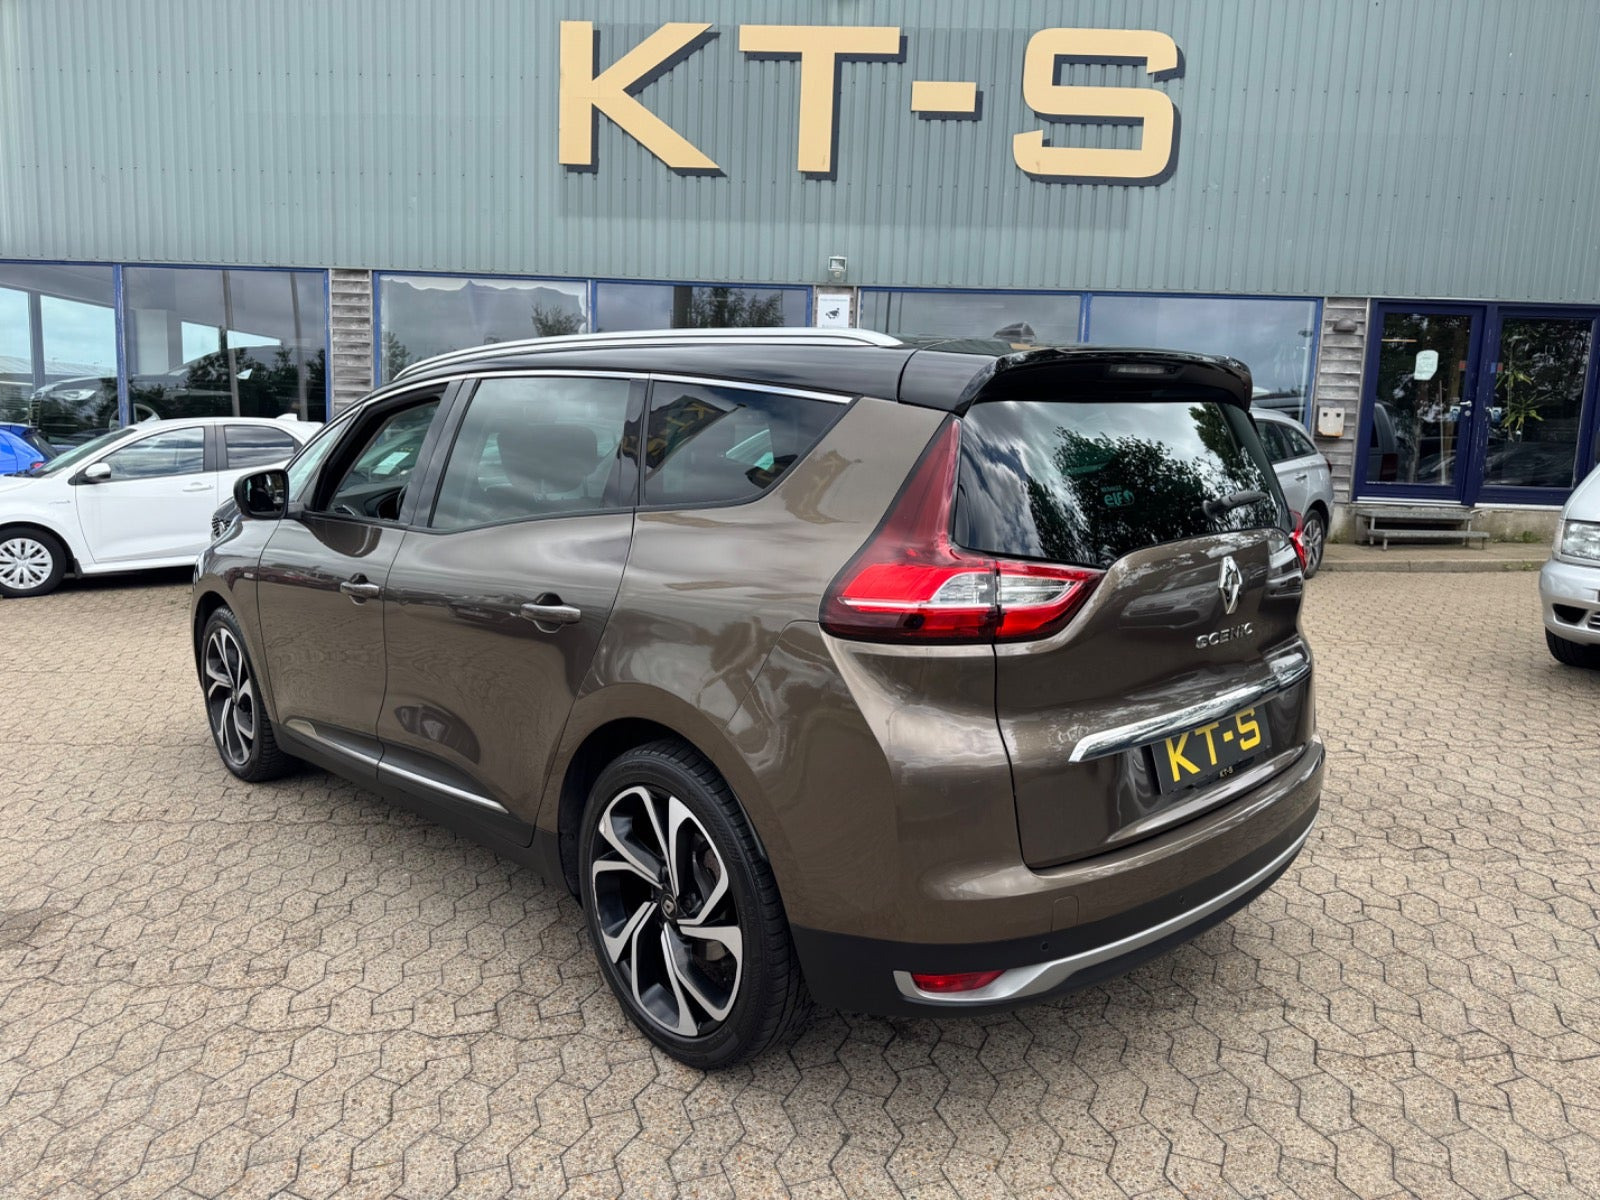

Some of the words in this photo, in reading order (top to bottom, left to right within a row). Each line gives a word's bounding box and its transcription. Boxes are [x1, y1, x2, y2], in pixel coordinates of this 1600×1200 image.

[558, 20, 1180, 179] KT-S
[1195, 622, 1254, 649] SCENIC
[1165, 708, 1261, 782] KT-S
